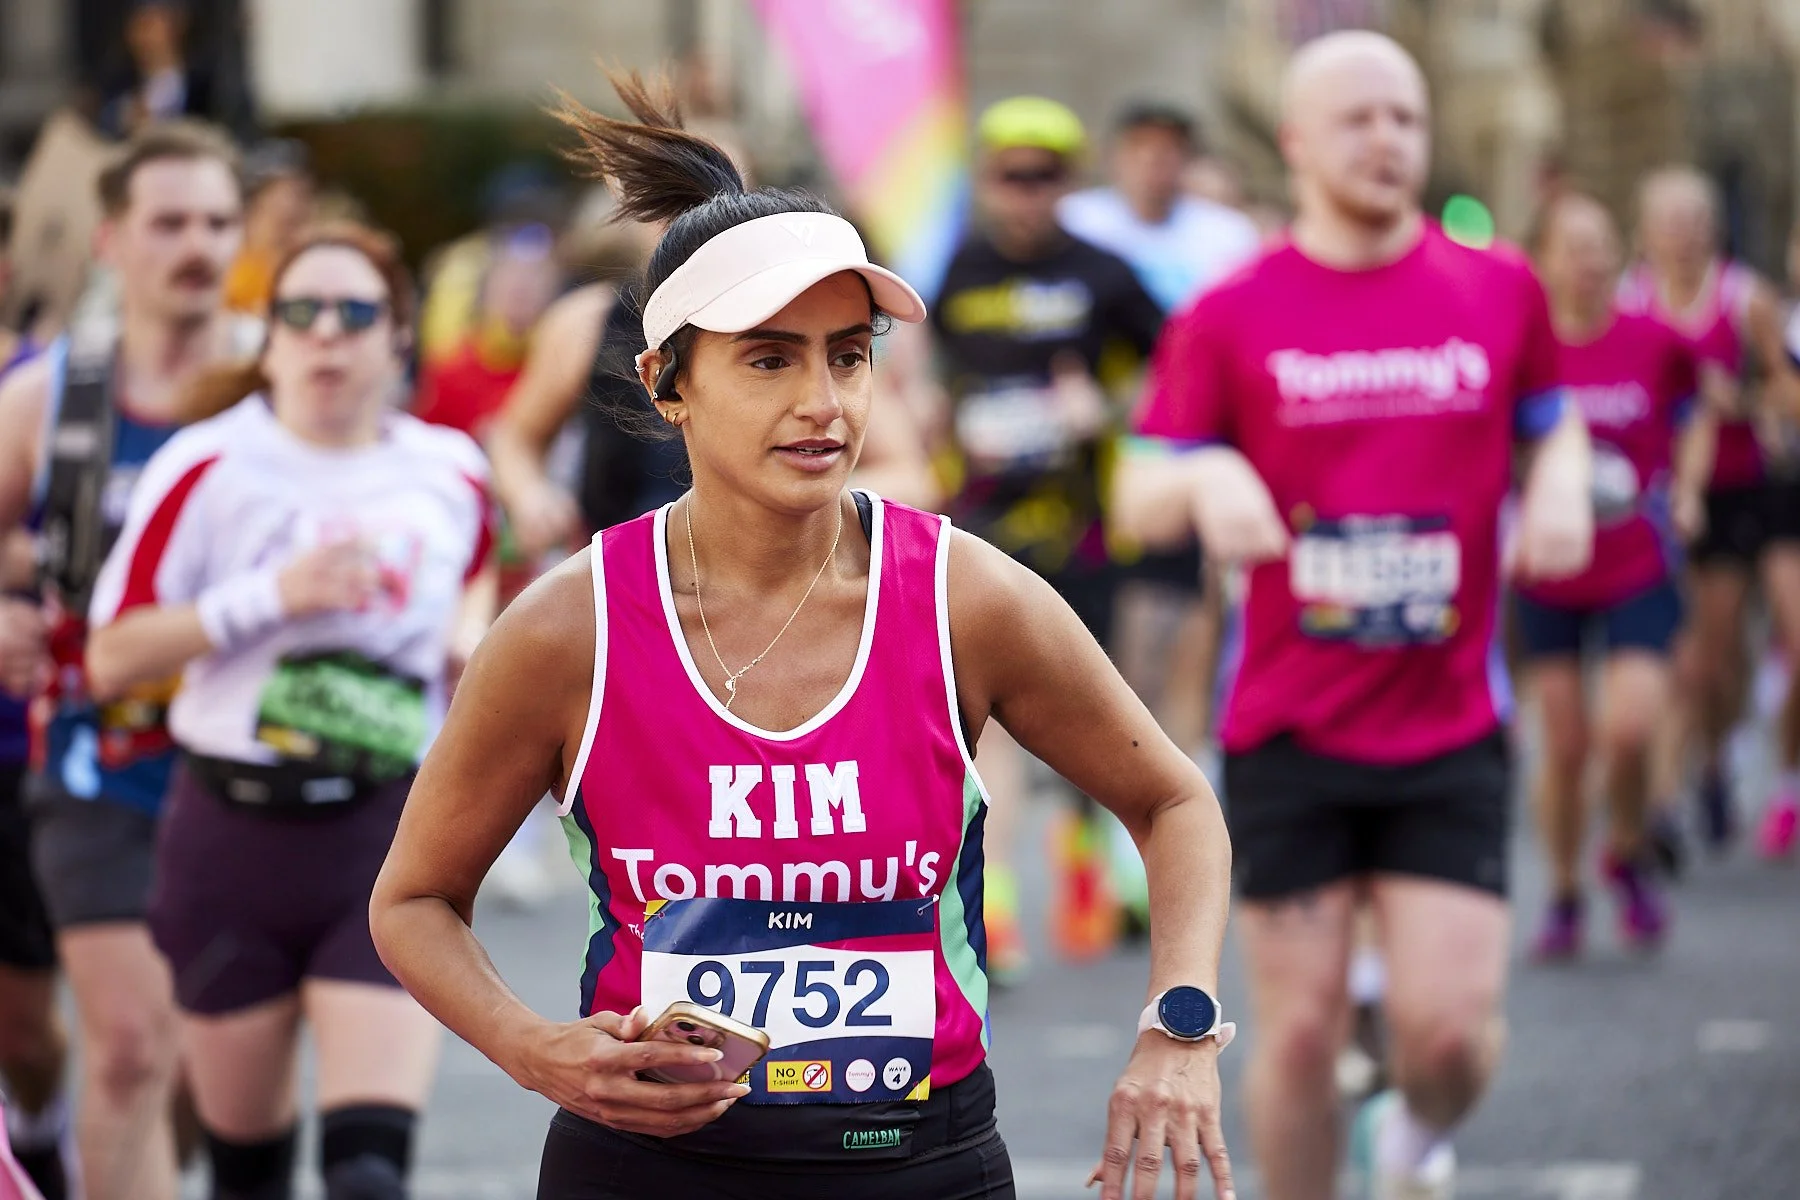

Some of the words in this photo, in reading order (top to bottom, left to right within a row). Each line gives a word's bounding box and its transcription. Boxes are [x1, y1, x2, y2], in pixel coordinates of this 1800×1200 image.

[708, 760, 867, 839] KIM
[610, 840, 942, 904] Tommy's
[768, 911, 813, 931] KIM
[686, 959, 892, 1029] 9752
[776, 1068, 796, 1078] NO
[892, 1073, 901, 1085] 4
